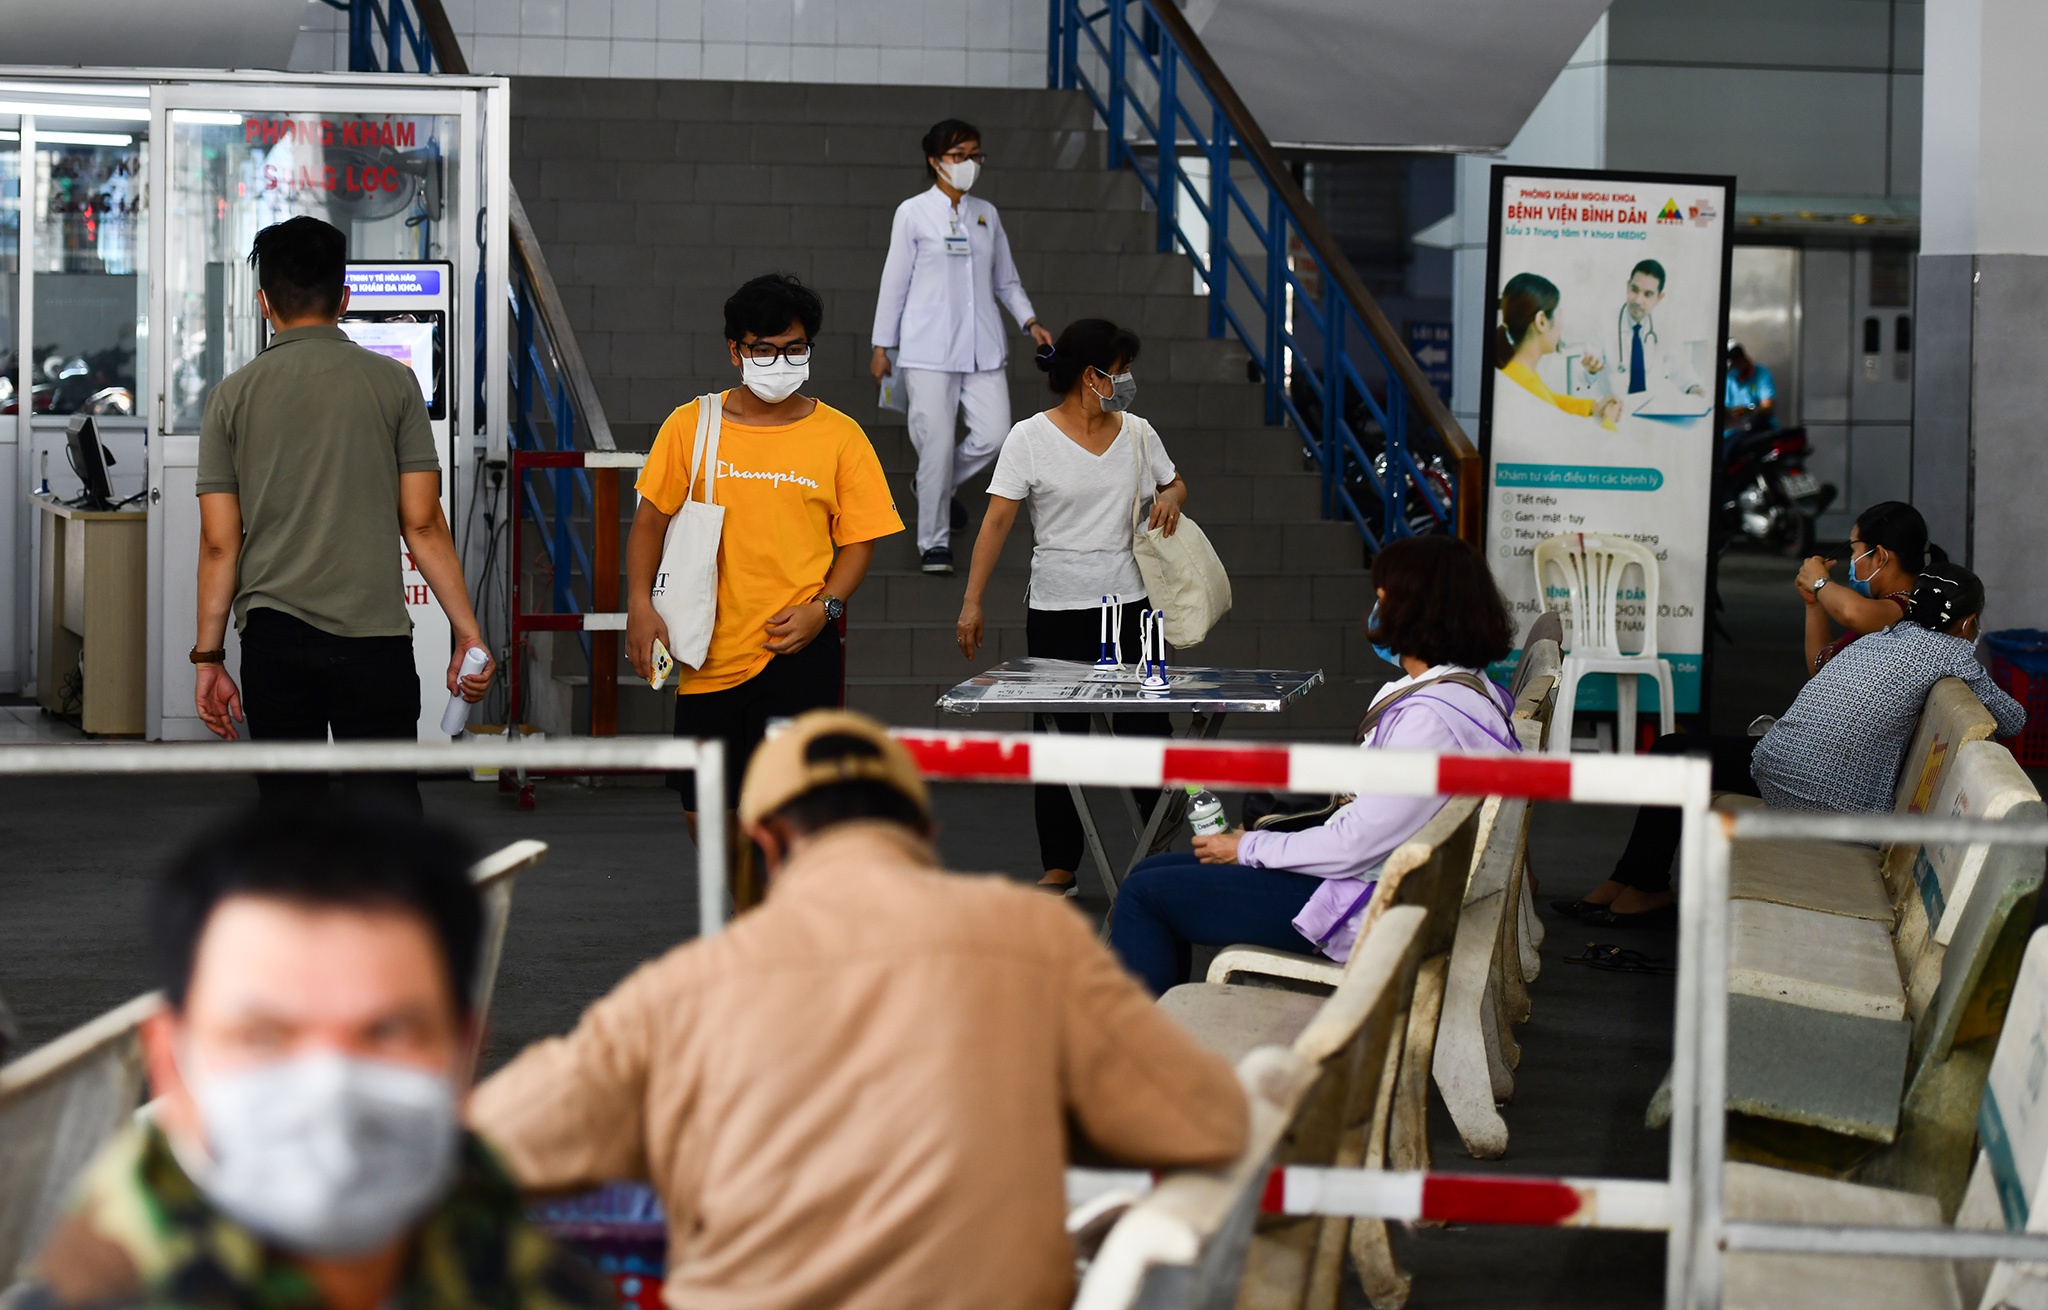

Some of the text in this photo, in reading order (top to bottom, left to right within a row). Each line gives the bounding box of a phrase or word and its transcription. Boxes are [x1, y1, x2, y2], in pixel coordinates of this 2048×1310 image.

[246, 112, 415, 147] PHÒNG KHÁM
[346, 166, 399, 200] LỌC
[1520, 189, 1551, 200] PHÒNG
[1554, 189, 1579, 201] KHÁM
[1612, 194, 1636, 203] KHOA
[1508, 202, 1647, 225] BỆNH VIỆN BÌNH DÂN
[1525, 227, 1531, 235] 3
[1534, 227, 1559, 239] Trung
[1583, 229, 1589, 237] Y
[1591, 229, 1614, 239] khoa
[1617, 231, 1647, 240] MEDIC
[398, 283, 423, 292] KHOA
[717, 460, 818, 488] Champion
[1498, 469, 1527, 481] Khám
[1621, 473, 1647, 485] bệnh
[1515, 510, 1535, 522] Gan
